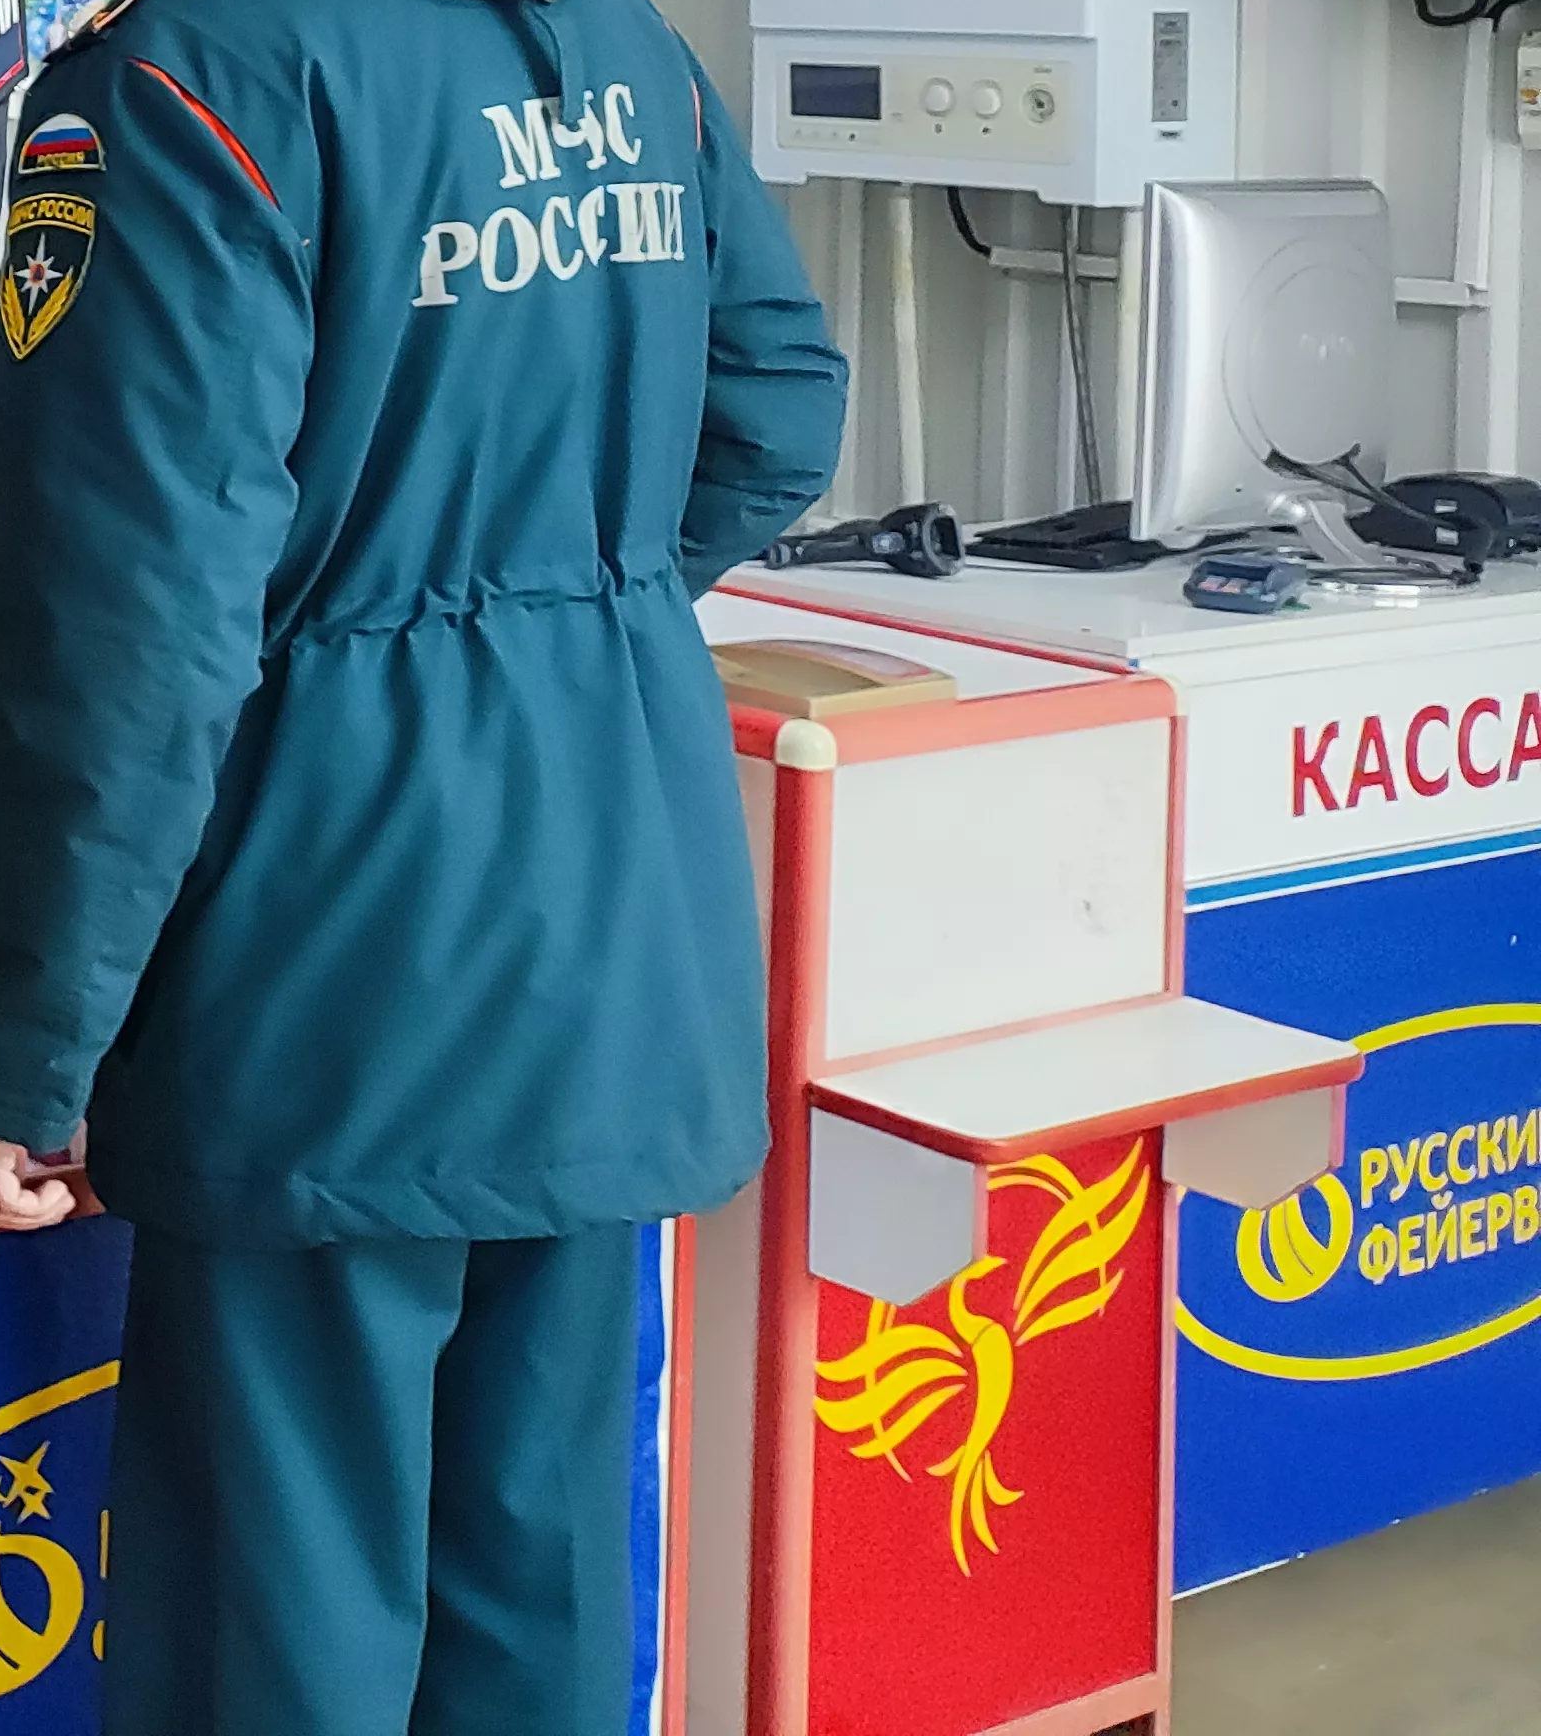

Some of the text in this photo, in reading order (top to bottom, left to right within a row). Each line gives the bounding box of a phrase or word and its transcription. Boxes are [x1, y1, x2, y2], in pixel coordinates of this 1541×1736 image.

[481, 83, 642, 191] МЧС
[37, 198, 93, 229] РОССИИ
[412, 182, 686, 309] РОССИИ
[1292, 691, 1541, 818] КАССА
[1360, 1106, 1541, 1211] РУССКИ
[1357, 1183, 1541, 1286] ФЕЙЕРВ
